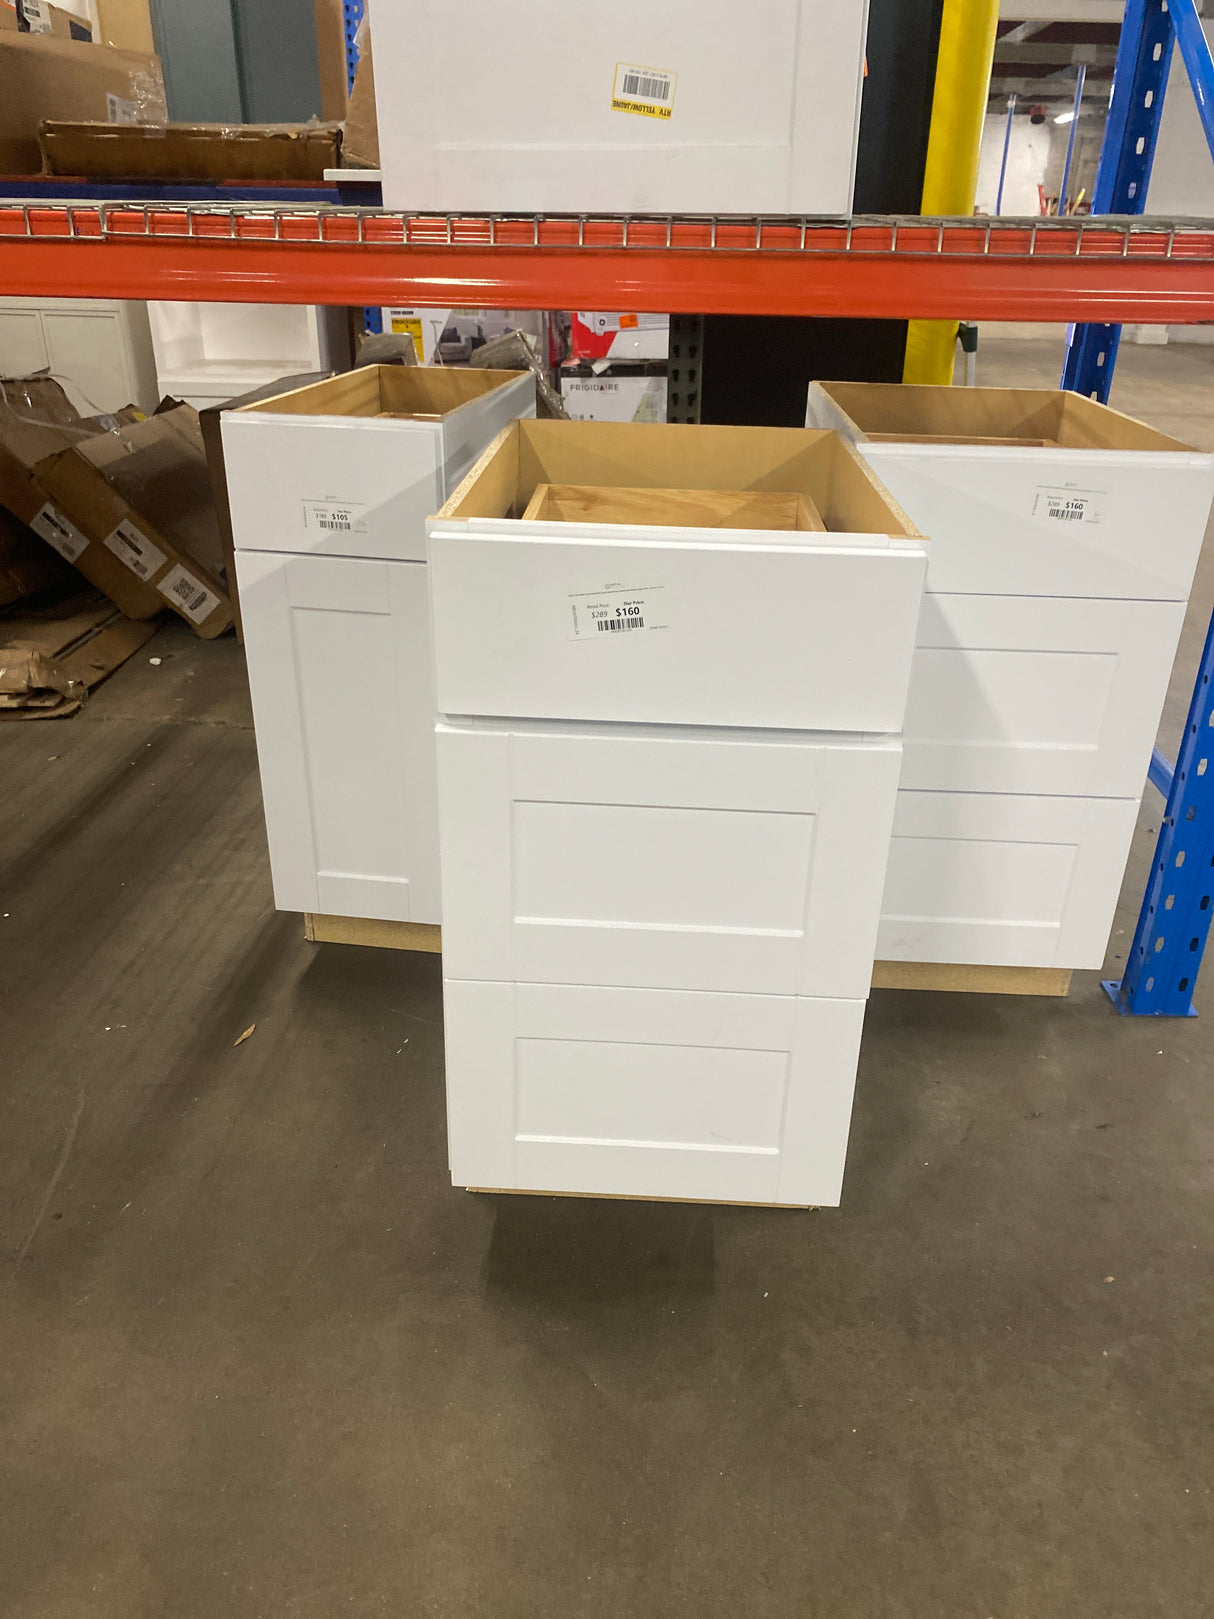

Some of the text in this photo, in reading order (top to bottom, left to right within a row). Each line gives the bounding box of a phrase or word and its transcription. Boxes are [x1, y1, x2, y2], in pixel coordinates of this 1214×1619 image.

[570, 383, 620, 392] FRIGIDAIRE
[1066, 501, 1083, 510] $160
[332, 513, 348, 521] $105
[591, 611, 608, 619] $289
[615, 606, 640, 617] $160
